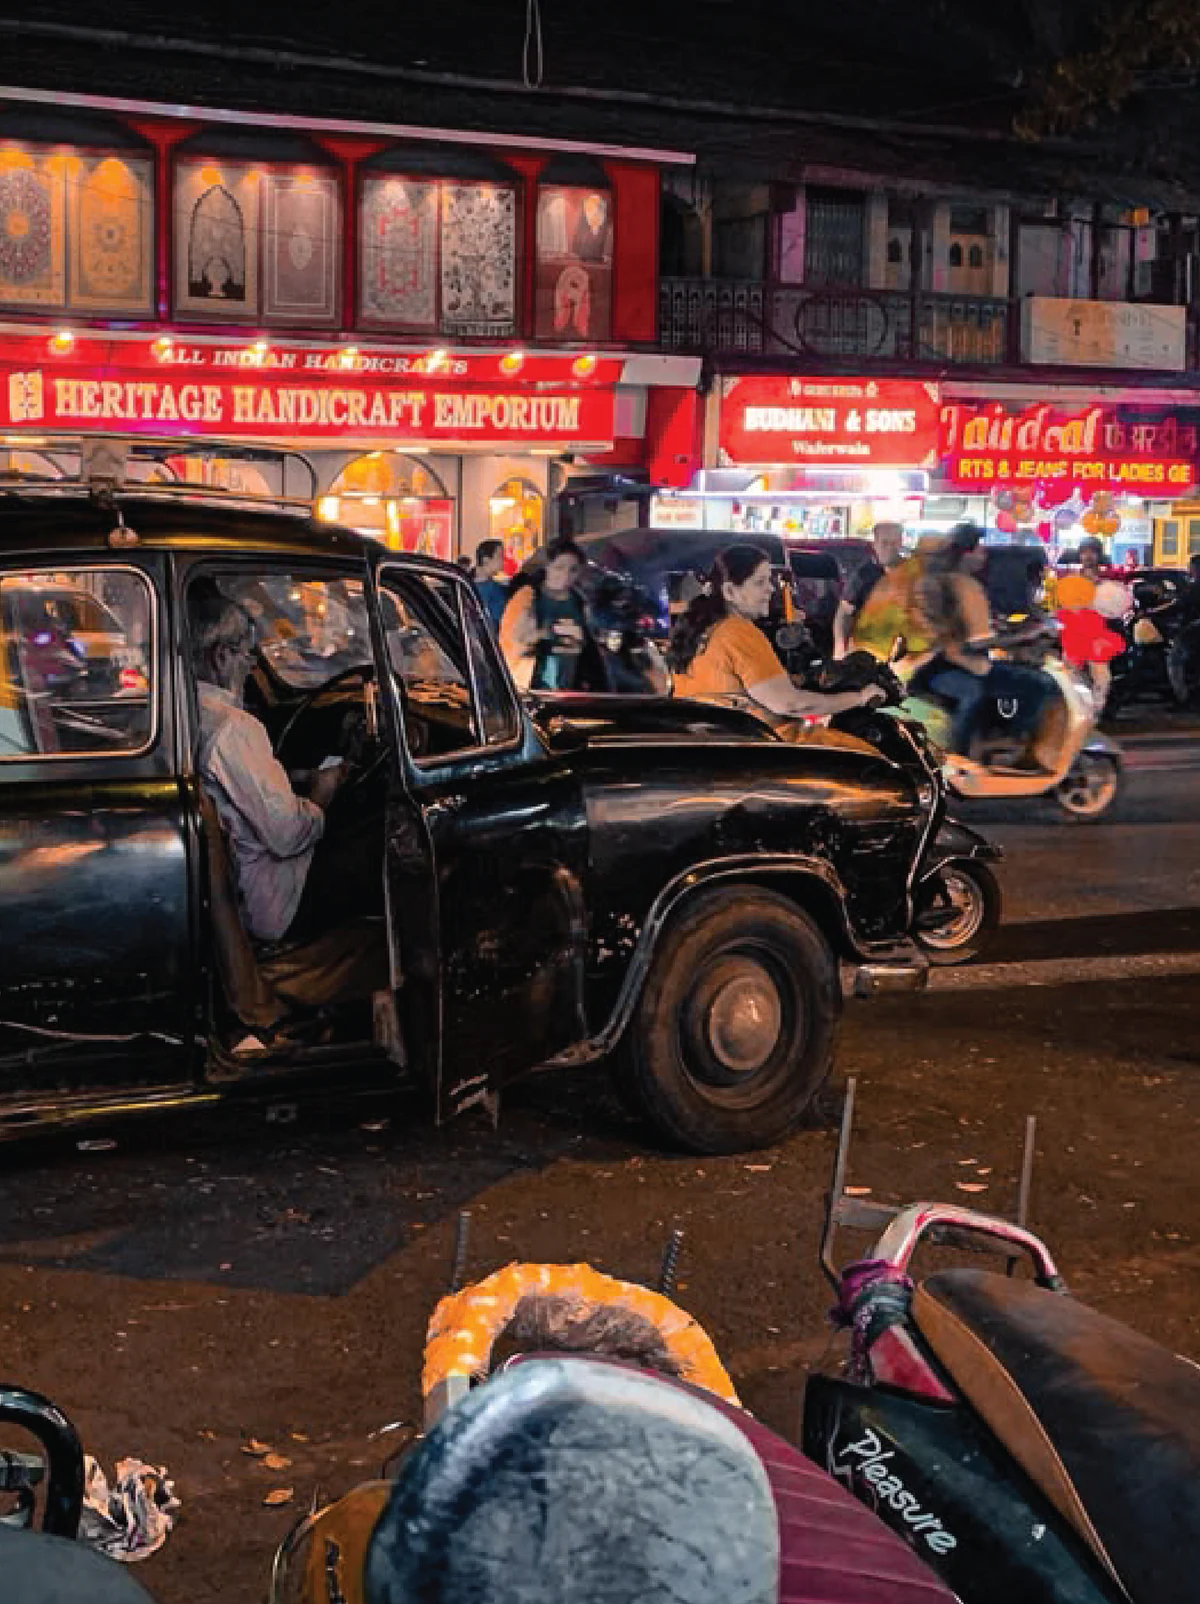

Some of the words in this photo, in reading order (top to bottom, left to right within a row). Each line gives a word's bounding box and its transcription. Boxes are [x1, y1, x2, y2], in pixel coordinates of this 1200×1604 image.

[158, 348, 205, 365] ALL
[212, 350, 298, 369] INDIAN
[54, 378, 223, 422] HERITAGE
[232, 385, 426, 428] HANDICRAFT
[434, 392, 580, 431] EMPORIUM
[744, 408, 836, 431] BUDHANI
[845, 408, 861, 431] &
[865, 410, 916, 431] SONS
[997, 459, 1010, 478] &
[1072, 461, 1105, 479] FOR
[1109, 462, 1164, 482] LADIES
[839, 1428, 958, 1554] Pleasure
